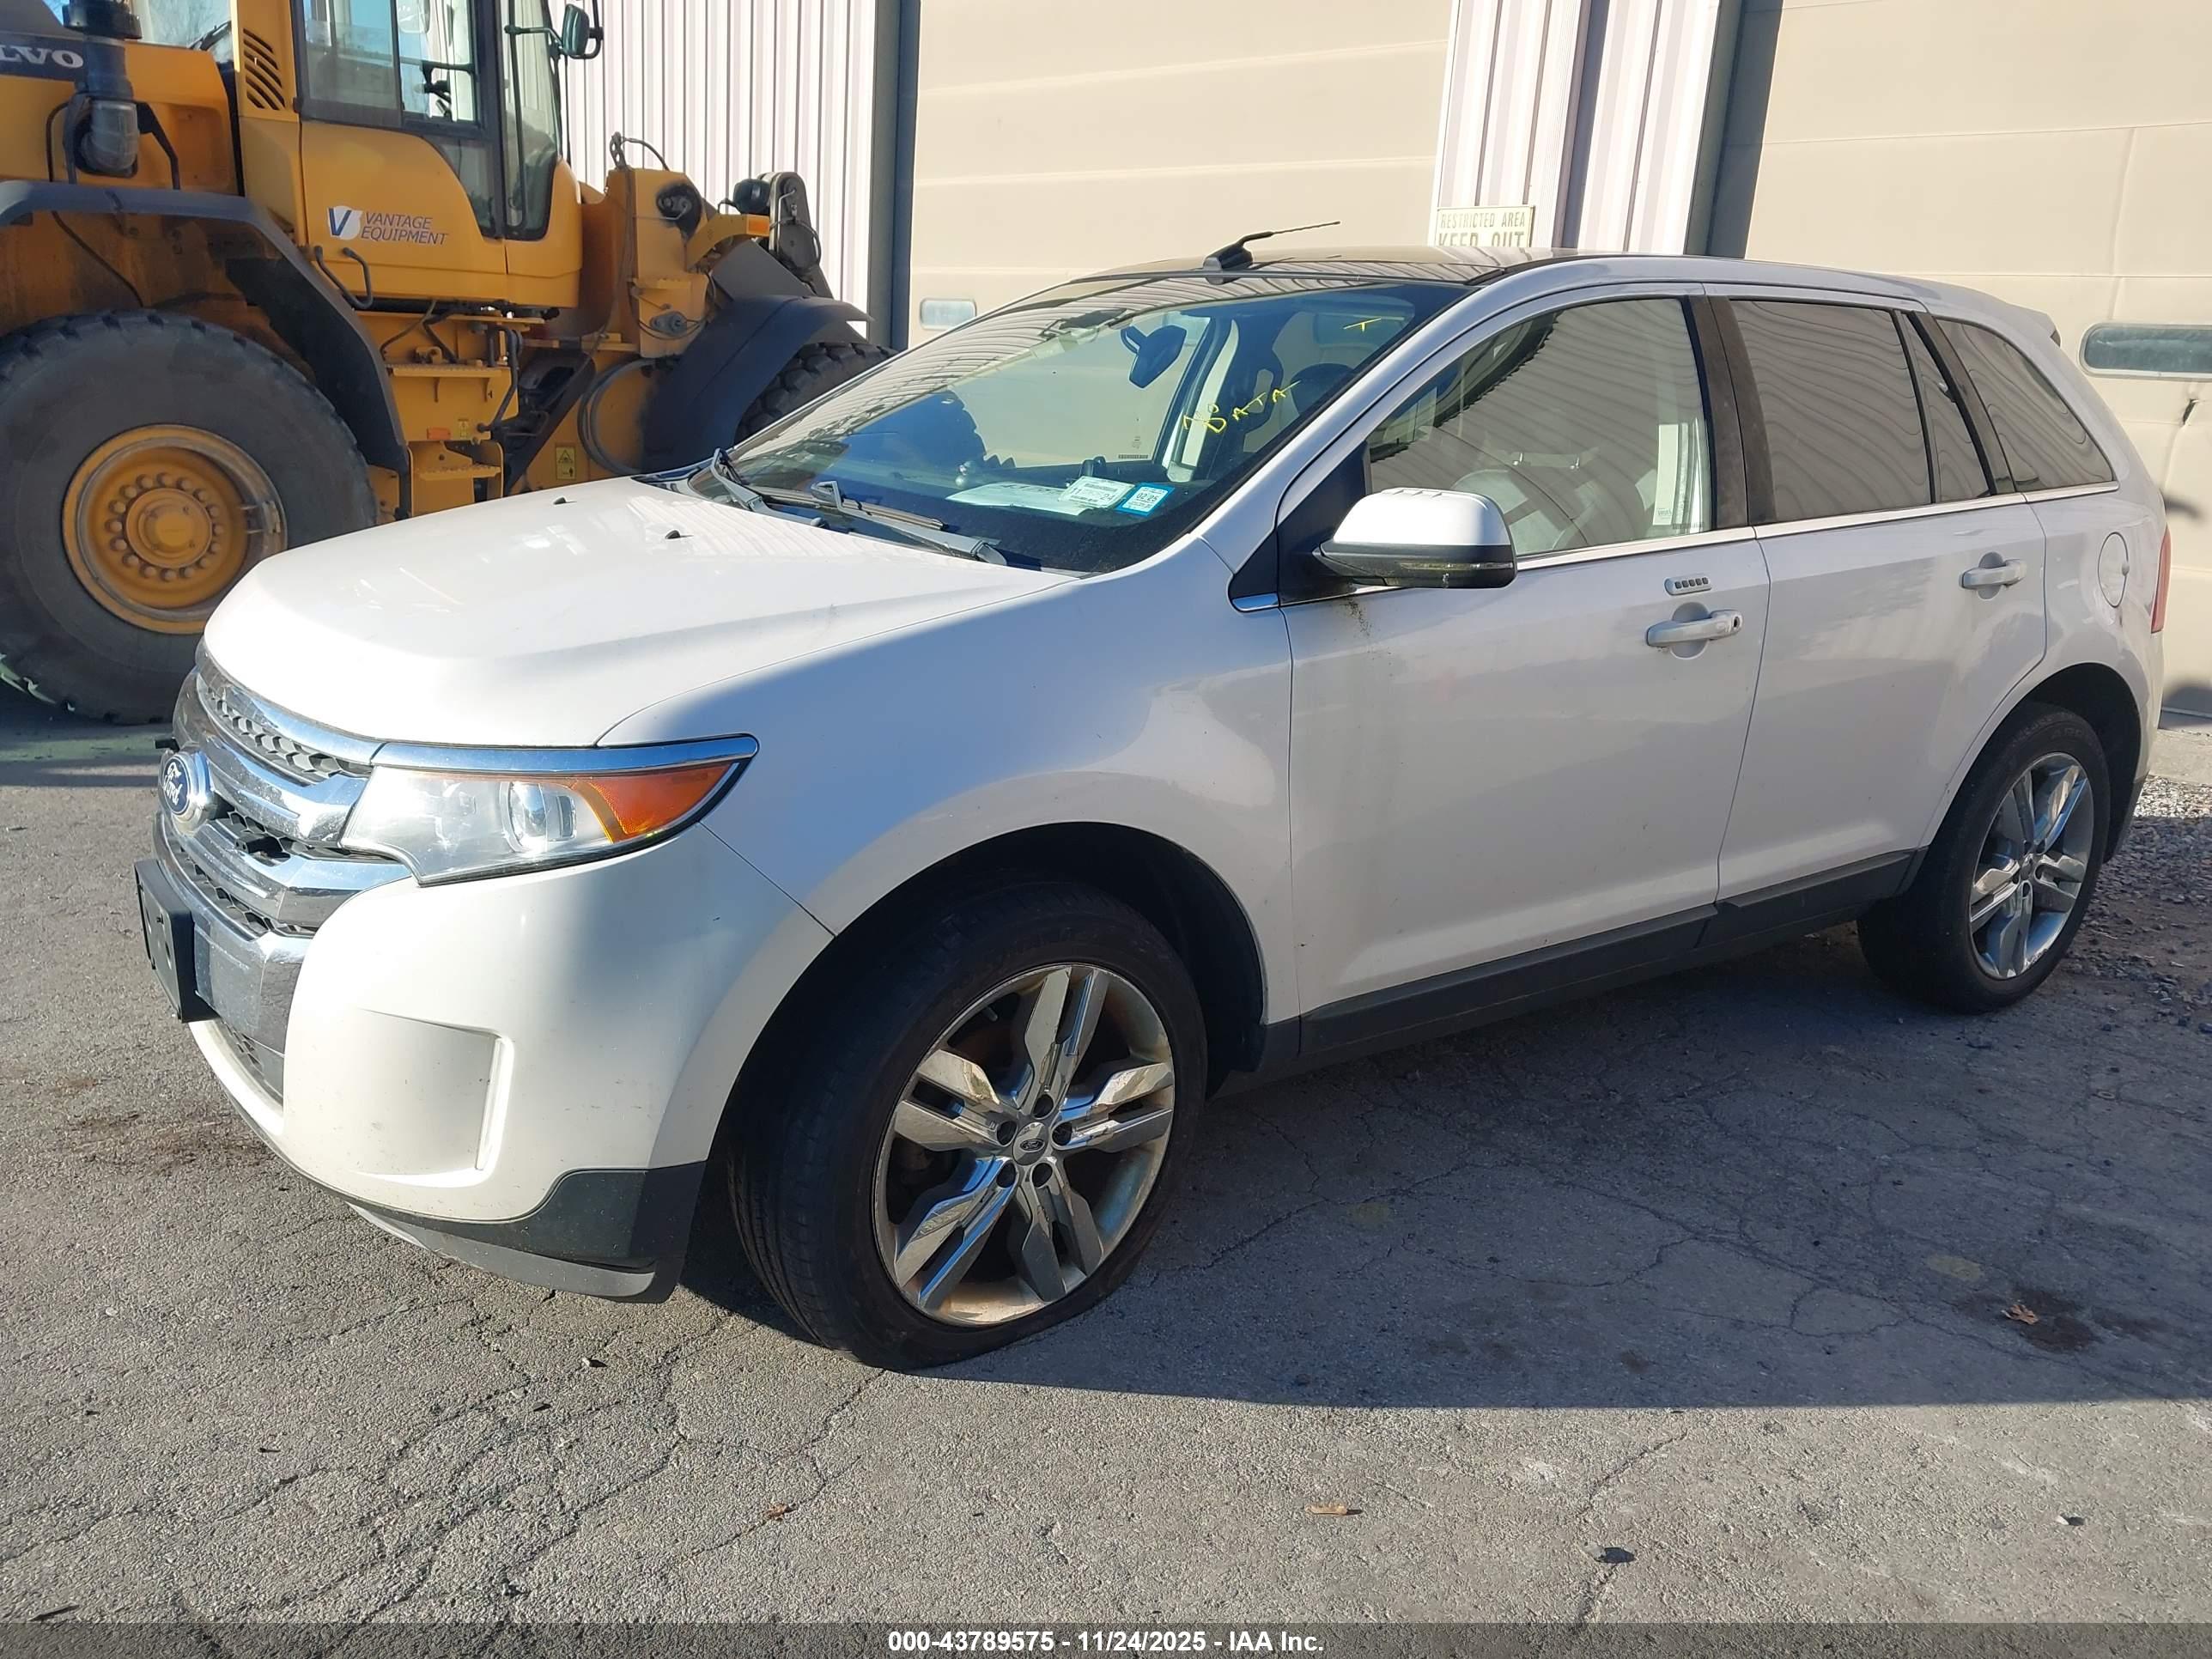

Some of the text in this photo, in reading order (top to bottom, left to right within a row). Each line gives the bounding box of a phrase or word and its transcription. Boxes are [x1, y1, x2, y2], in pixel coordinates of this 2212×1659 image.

[365, 212, 433, 230] VANTAGE
[1441, 211, 1525, 228] RESTRICTED AREA
[361, 226, 448, 245] EQUIPMENT
[163, 762, 183, 805] Ford
